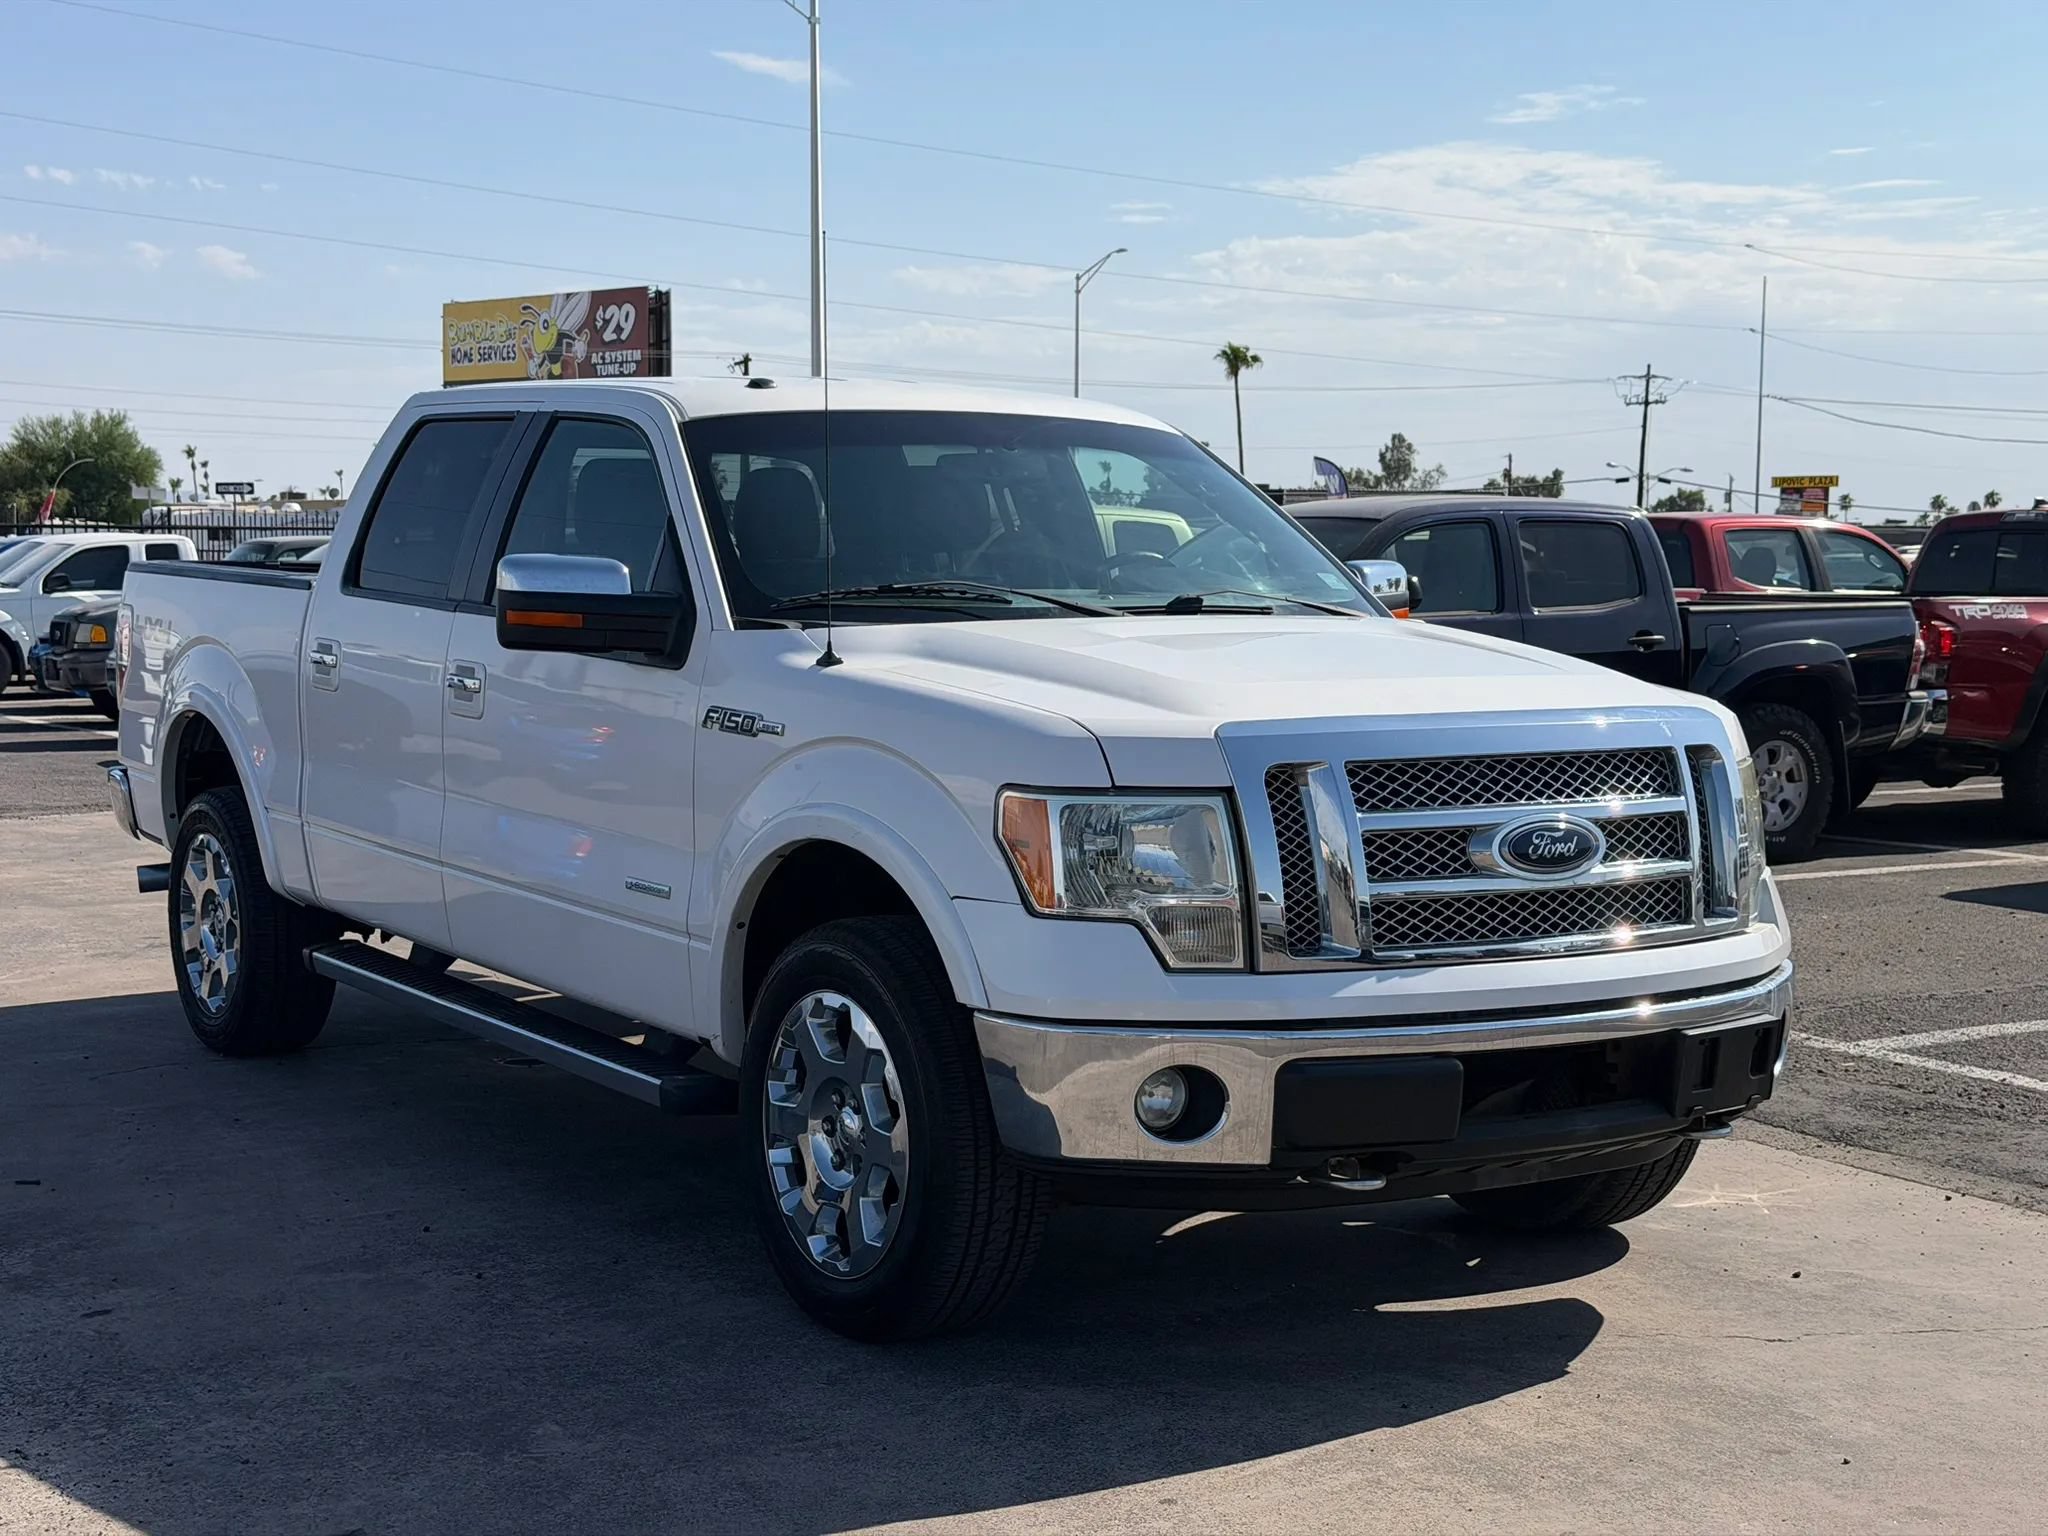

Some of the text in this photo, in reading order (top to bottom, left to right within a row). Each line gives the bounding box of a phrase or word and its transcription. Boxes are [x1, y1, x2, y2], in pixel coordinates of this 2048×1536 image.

[595, 302, 637, 343] $29
[451, 343, 517, 365] HOME SERVICES
[591, 349, 642, 365] AC SYSTEM
[596, 363, 637, 376] TUNE-UP
[1808, 476, 1834, 486] PLAZA
[1948, 604, 1992, 619] TRD
[1528, 830, 1579, 859] Ford
